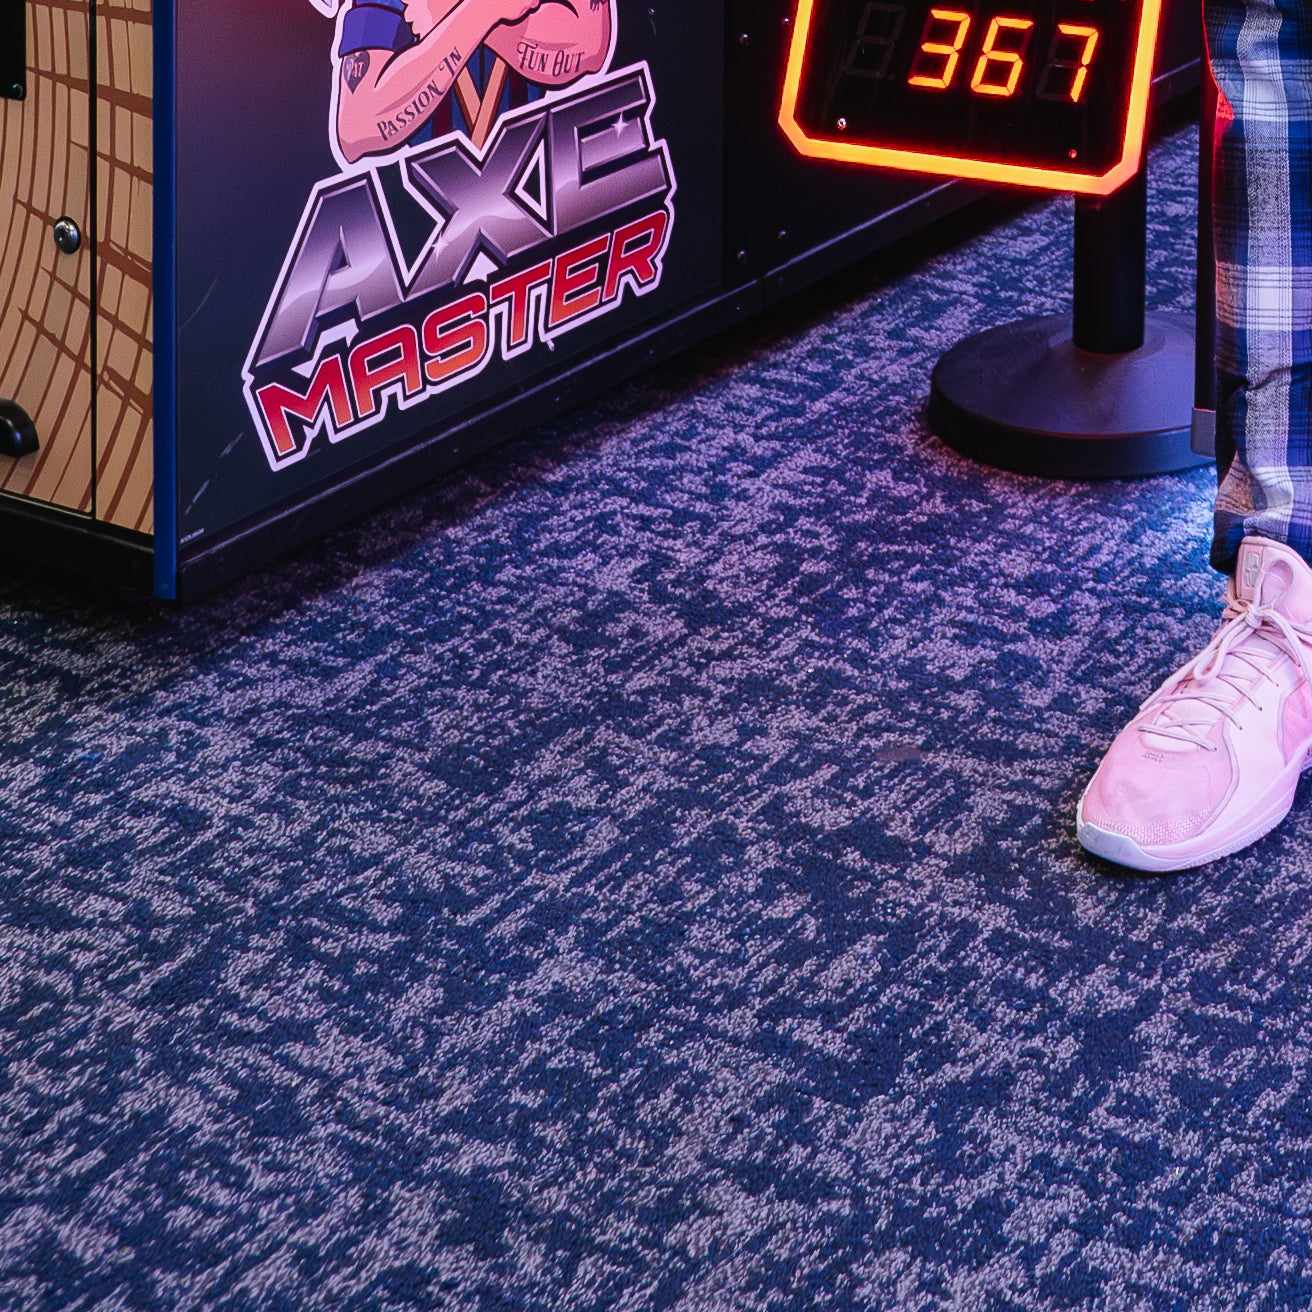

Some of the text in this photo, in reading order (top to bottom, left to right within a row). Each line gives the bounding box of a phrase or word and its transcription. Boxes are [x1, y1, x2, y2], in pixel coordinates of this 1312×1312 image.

[376, 79, 447, 142] PASSION
[908, 9, 1099, 103] 367
[254, 75, 670, 369] AXE
[256, 210, 668, 457] MASTER
